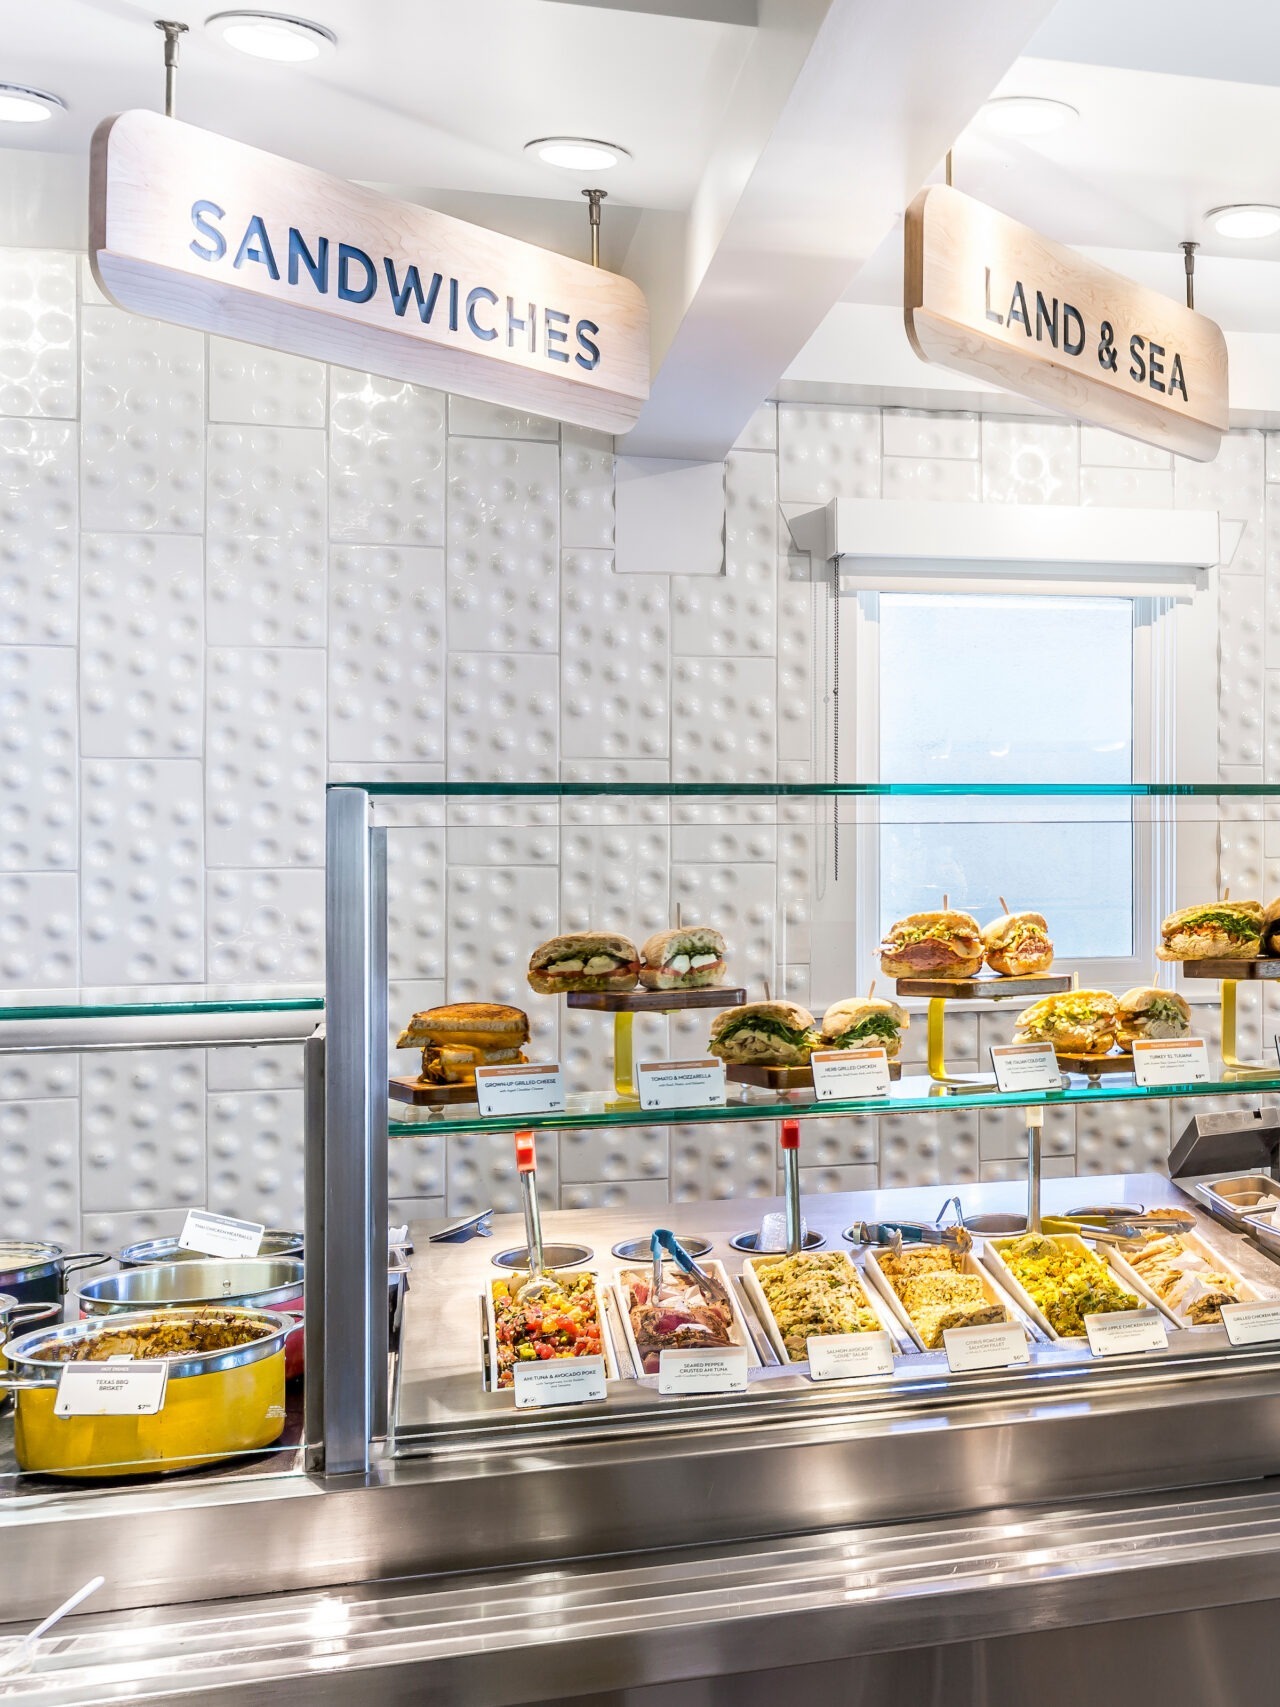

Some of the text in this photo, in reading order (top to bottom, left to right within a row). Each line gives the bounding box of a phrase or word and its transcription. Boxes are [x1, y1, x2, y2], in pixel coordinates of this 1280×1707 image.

[188, 199, 601, 372] SANDWICHES
[985, 265, 1190, 403] LAND & SEA
[679, 1073, 712, 1081] MOZZARELLA
[554, 1371, 582, 1379] AVOCADO
[582, 1369, 597, 1377] POKE
